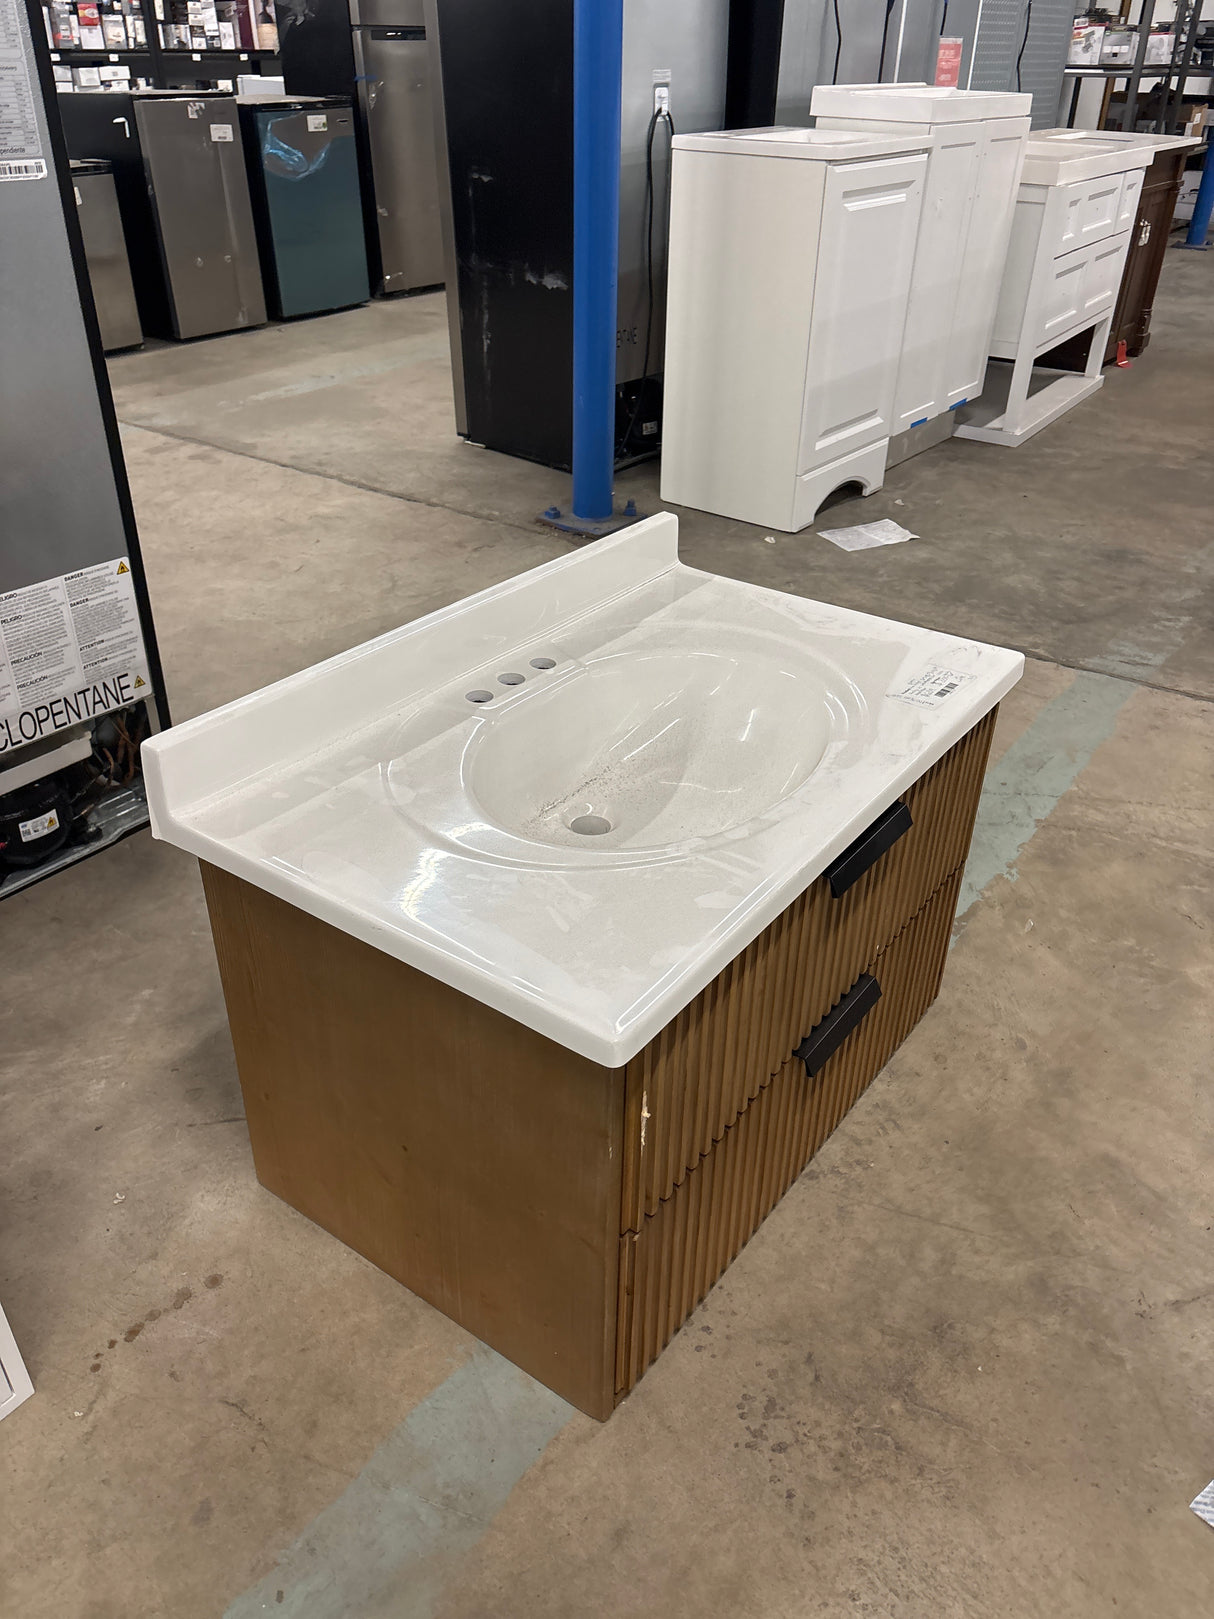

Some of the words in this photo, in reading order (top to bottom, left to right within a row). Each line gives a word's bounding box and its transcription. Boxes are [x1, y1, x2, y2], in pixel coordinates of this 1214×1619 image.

[64, 572, 84, 582] DANGER
[70, 598, 89, 608] DANGER
[1, 614, 22, 625] PELIGRO
[80, 639, 104, 652] ATTENTION
[11, 651, 42, 666] PRECAUCIÓN
[83, 657, 108, 670] ATTENTION
[17, 675, 48, 690] PRECAUCIÓN
